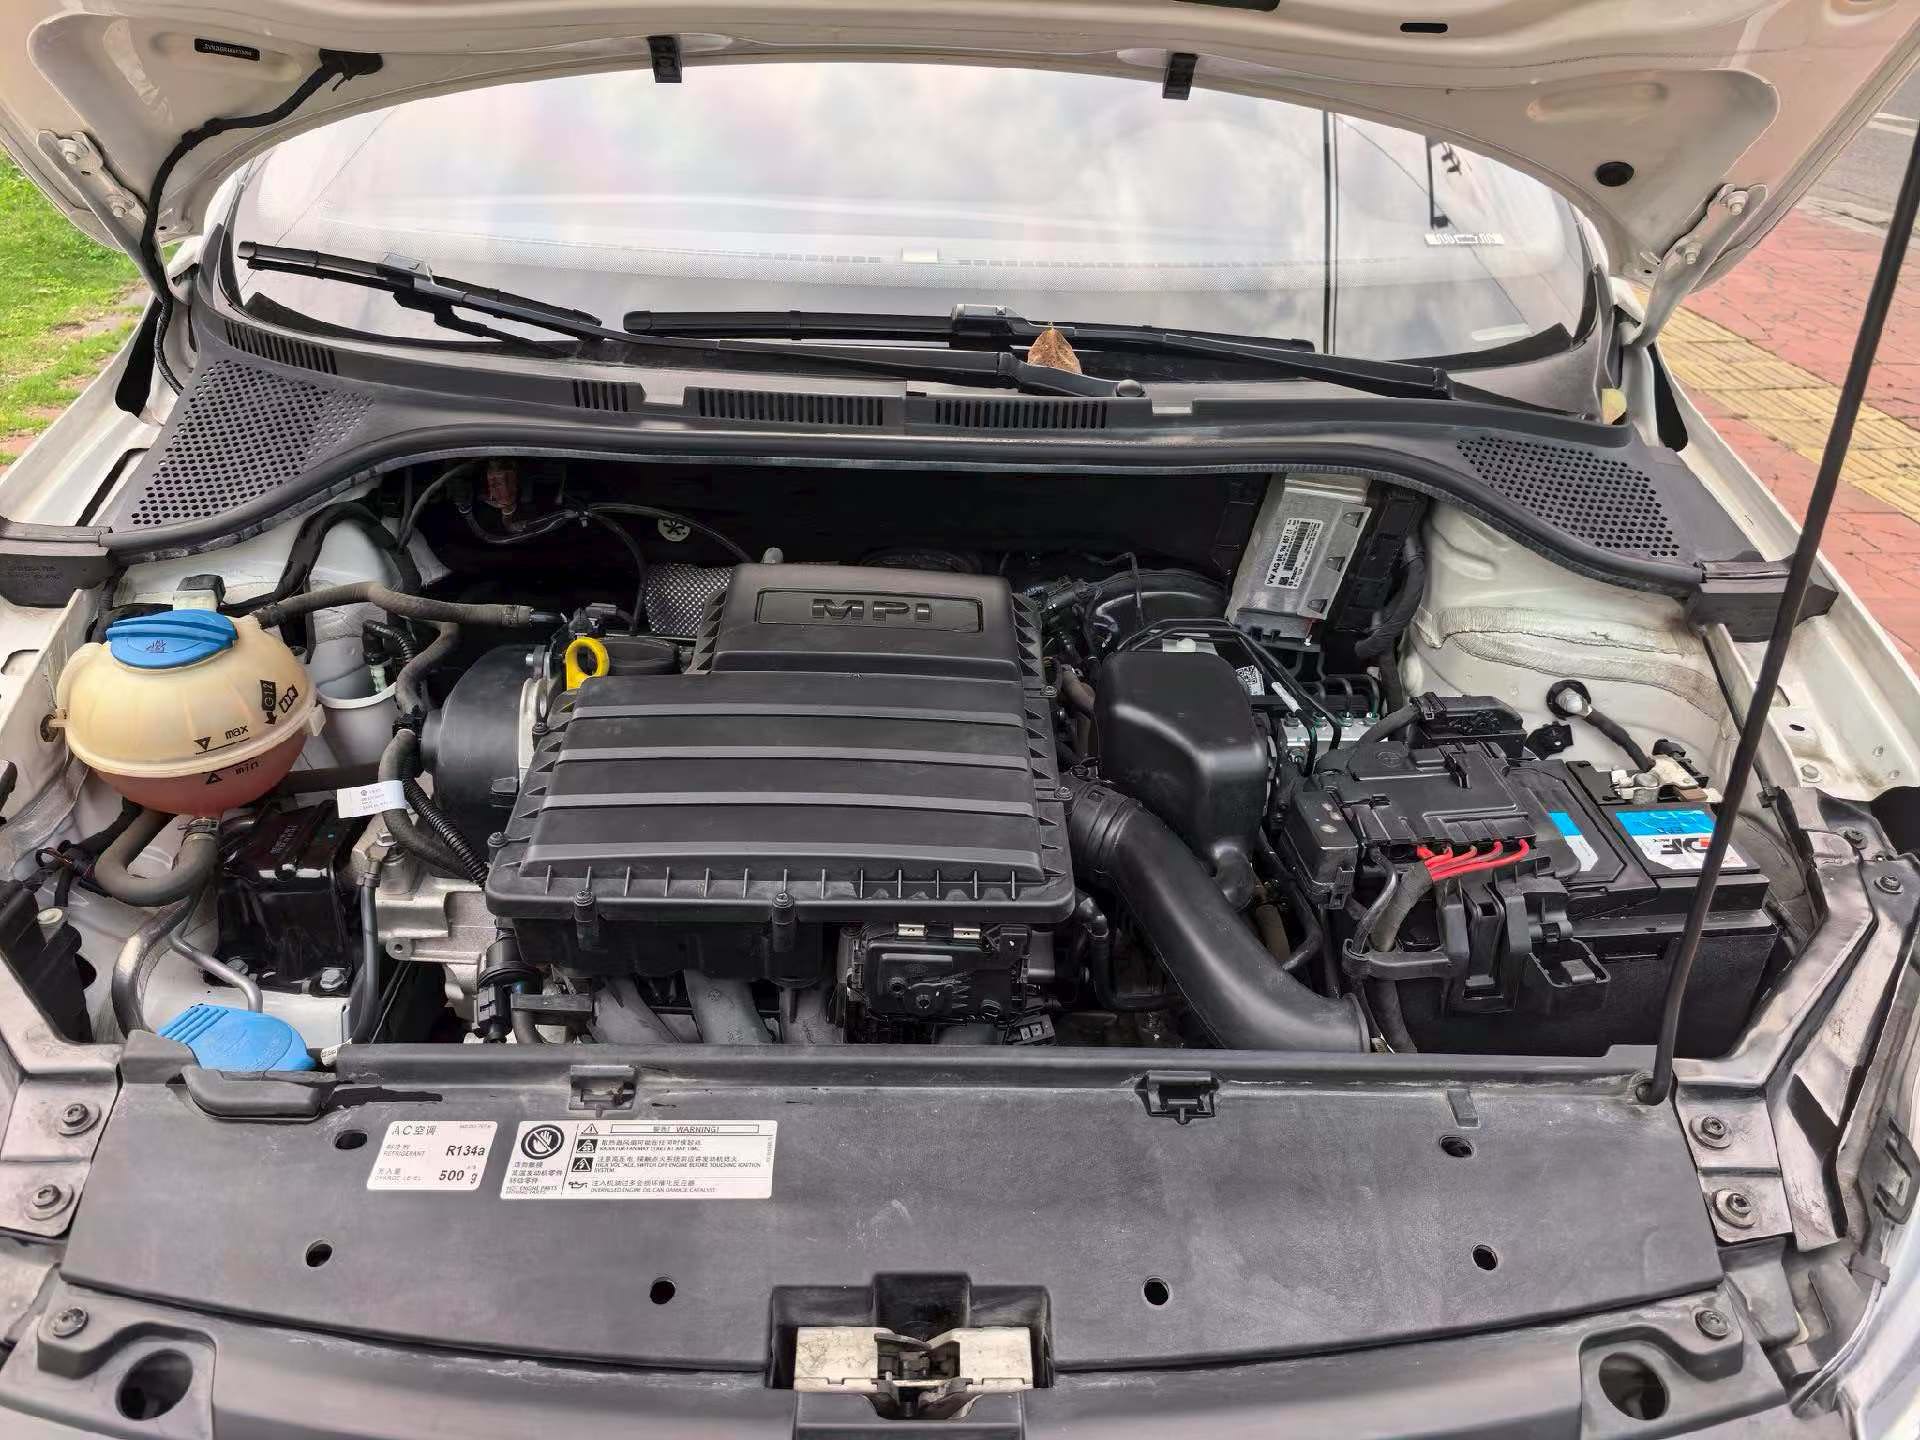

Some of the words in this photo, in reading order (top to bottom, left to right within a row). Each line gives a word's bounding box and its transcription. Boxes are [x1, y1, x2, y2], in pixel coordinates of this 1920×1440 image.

[811, 598, 931, 623] MPI
[225, 725, 249, 740] max
[234, 760, 260, 776] min
[675, 1126, 720, 1134] WARNING!
[446, 1144, 486, 1157] R134a
[439, 1169, 465, 1182] 500
[470, 1172, 479, 1185] g
